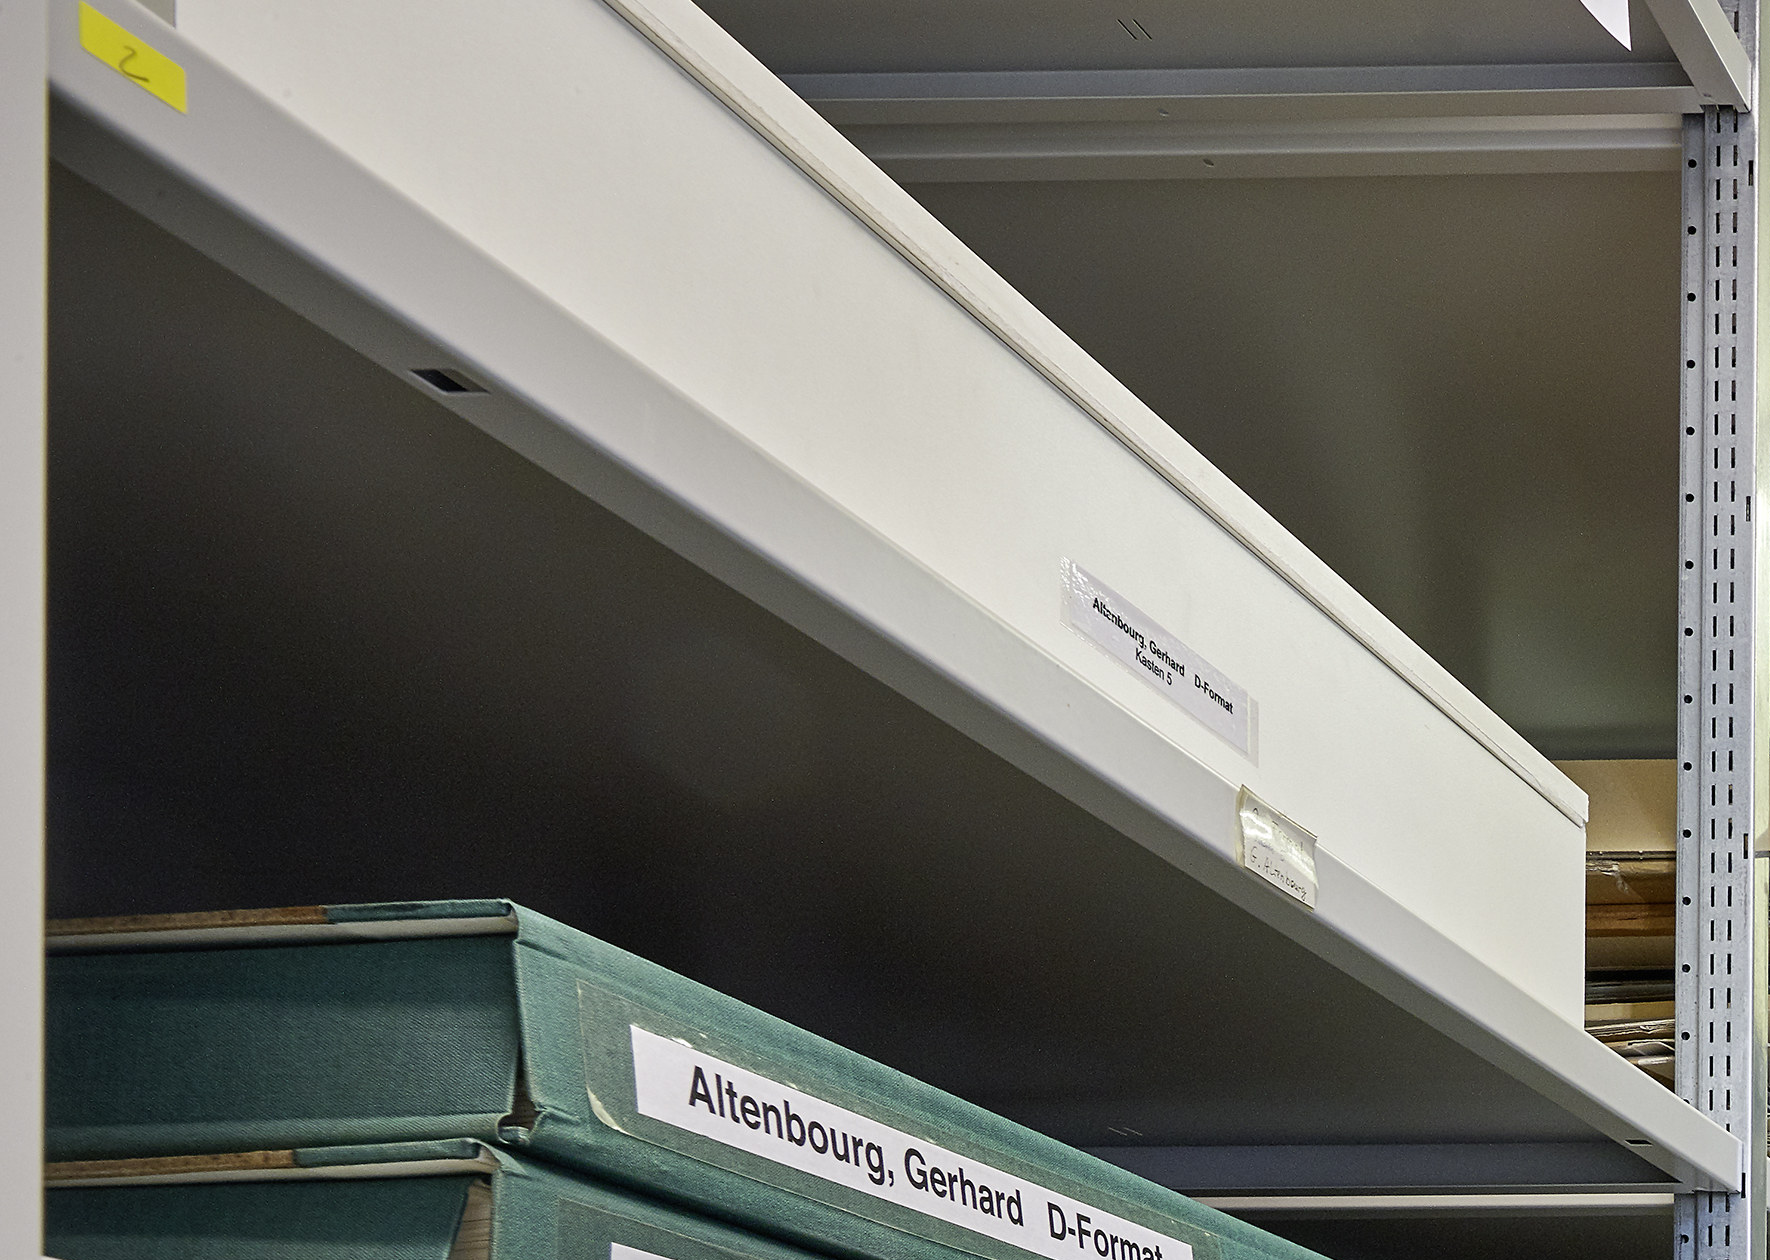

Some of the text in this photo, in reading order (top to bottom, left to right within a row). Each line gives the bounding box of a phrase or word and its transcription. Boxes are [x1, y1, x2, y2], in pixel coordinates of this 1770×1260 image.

[119, 45, 149, 82] 2
[1093, 597, 1234, 714] Altenbourg, Gerhard D-Format
[1135, 648, 1173, 686] Kasten 5
[688, 1064, 895, 1187] Altenbourg,
[904, 1148, 1024, 1227] Gerhard
